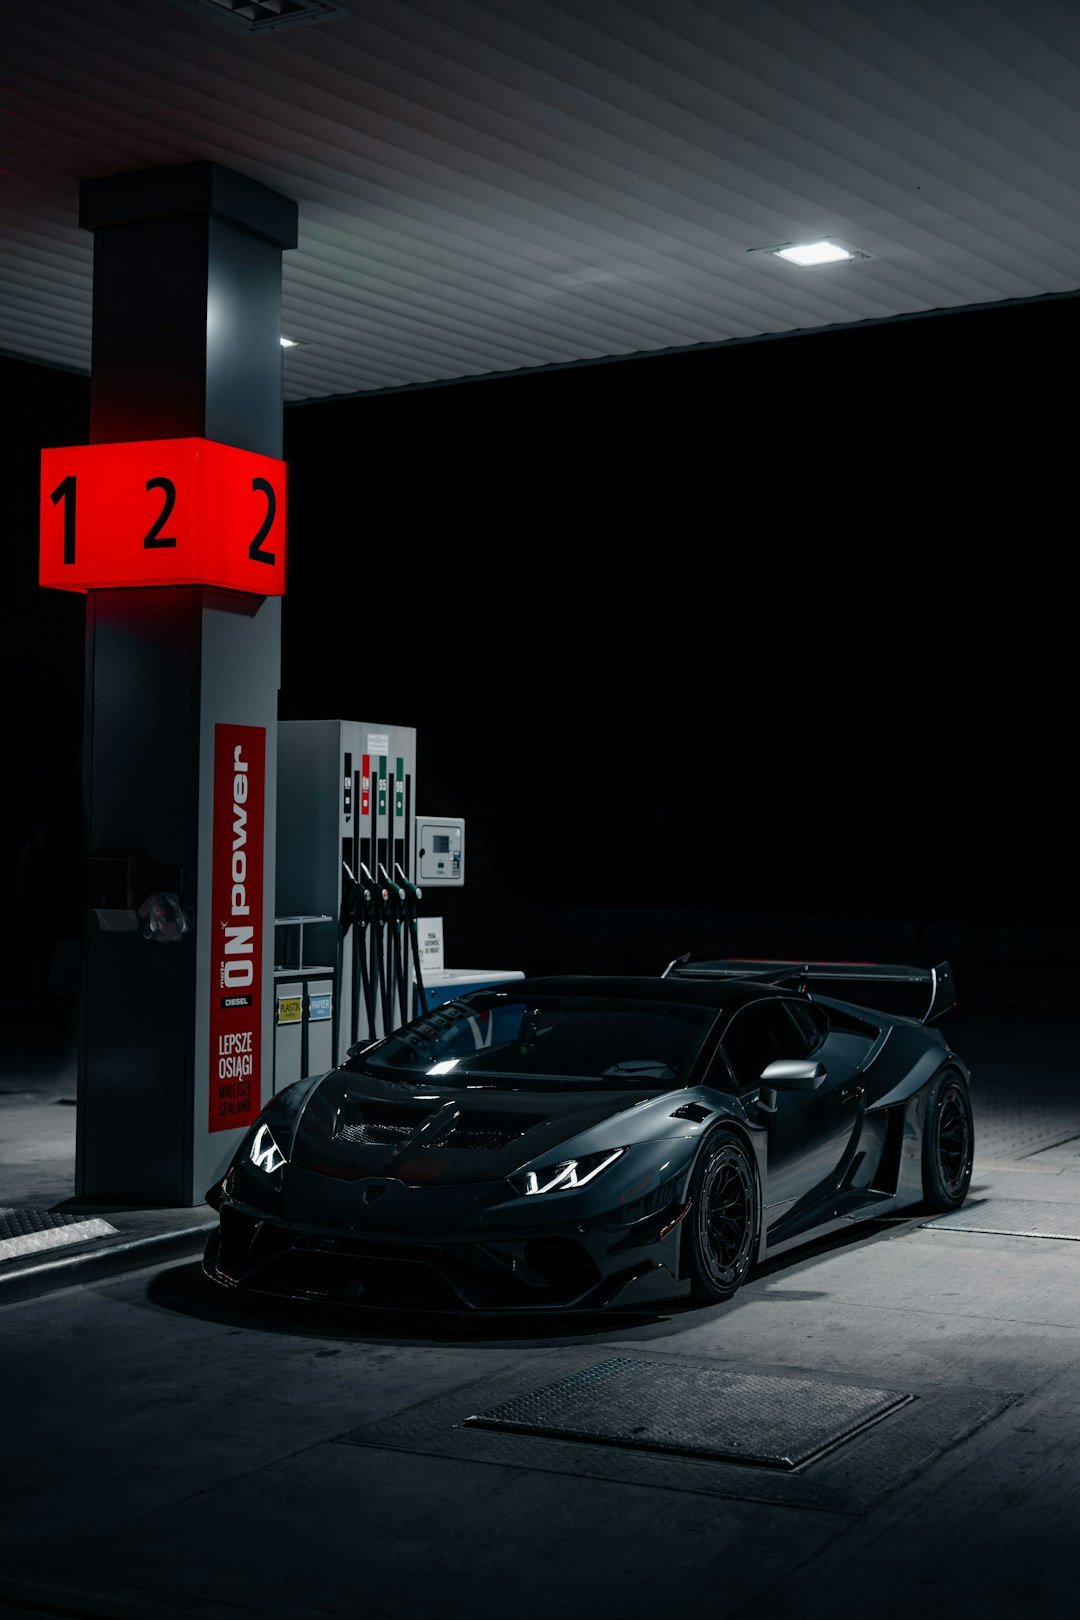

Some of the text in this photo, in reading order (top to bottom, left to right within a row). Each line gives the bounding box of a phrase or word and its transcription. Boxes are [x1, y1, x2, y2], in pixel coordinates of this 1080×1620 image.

[50, 475, 177, 565] 1 2
[248, 477, 277, 566] 2
[225, 745, 254, 988] ON power
[225, 997, 248, 1007] DIESEL
[311, 999, 330, 1010] PAPIER
[218, 1031, 253, 1056] LEPSZE
[218, 1054, 253, 1082] OSIĄGI
[218, 1080, 252, 1099] MNIEJSZE
[218, 1097, 252, 1118] SPALANIE
